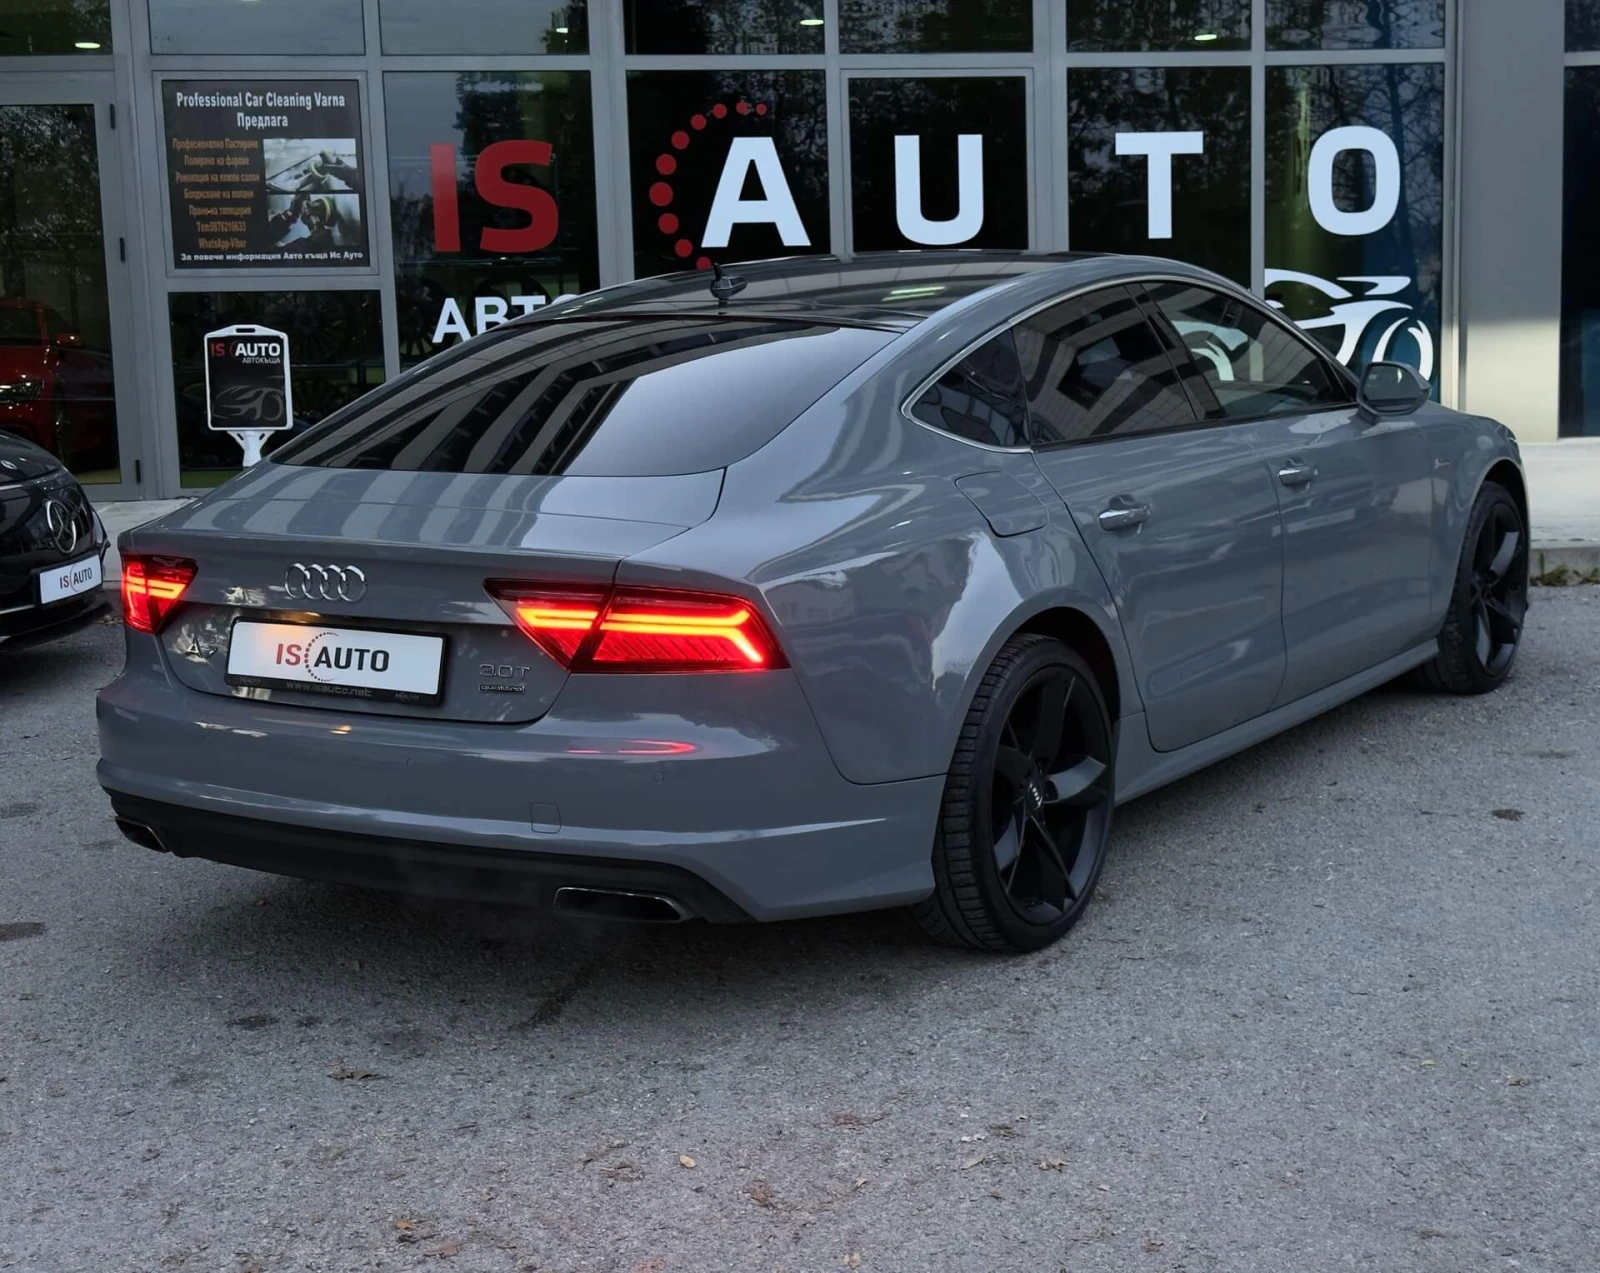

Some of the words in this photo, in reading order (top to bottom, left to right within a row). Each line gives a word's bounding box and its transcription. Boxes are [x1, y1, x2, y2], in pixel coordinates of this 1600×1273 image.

[176, 92, 242, 107] Professional
[245, 92, 263, 107] Car
[266, 92, 312, 110] Cleaning
[314, 92, 345, 107] Varna
[237, 112, 289, 130] Предлага
[210, 174, 219, 182] на
[222, 190, 231, 198] на
[430, 139, 559, 254] IS
[701, 125, 1402, 248] AUTO
[180, 253, 192, 261] За
[226, 252, 282, 262] информация
[283, 252, 303, 260] Авто
[305, 252, 328, 260] къща
[330, 251, 341, 259] Ис
[343, 251, 363, 260] Ауто
[432, 293, 580, 344] АВТ
[211, 343, 225, 356] IS
[235, 343, 281, 356] AUTO
[60, 575, 70, 589] IS
[73, 567, 93, 585] AUTO
[276, 643, 302, 666] IS
[313, 646, 390, 672] AUTO
[286, 681, 373, 698] www.isauto.net
